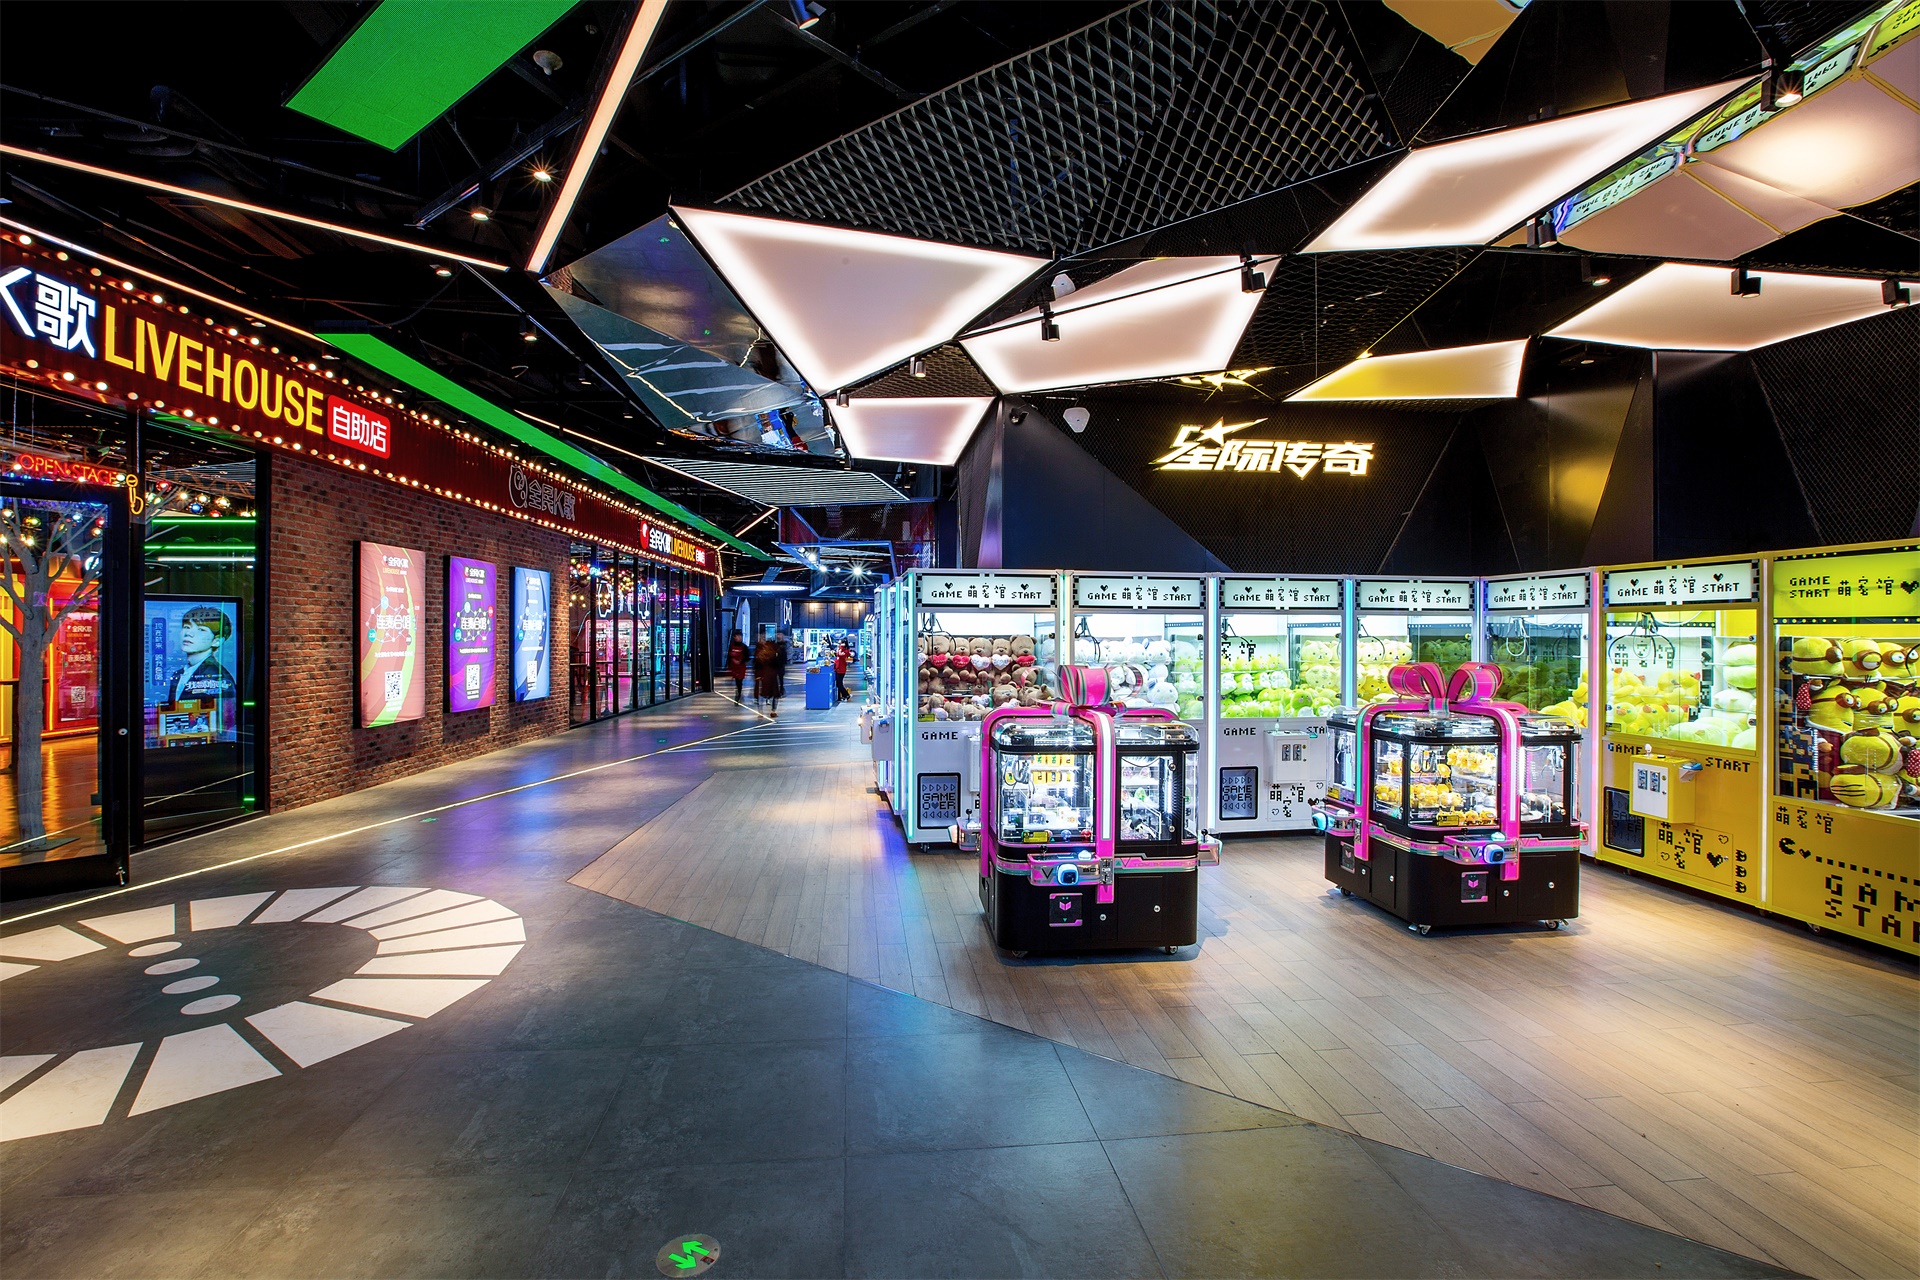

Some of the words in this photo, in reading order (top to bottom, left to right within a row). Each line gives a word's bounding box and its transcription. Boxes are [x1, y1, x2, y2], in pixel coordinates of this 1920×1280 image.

[105, 305, 324, 435] LIVEHOUSE
[332, 405, 387, 453] 自助店
[1149, 416, 1375, 480] 星际传奇
[20, 454, 68, 475] OPEN
[1790, 576, 1830, 586] GAME
[1618, 587, 1648, 597] GAME
[1702, 582, 1740, 593] START
[1789, 588, 1830, 599] START
[931, 590, 962, 598] GAME
[1011, 591, 1042, 599] START
[1087, 592, 1117, 600] GAME
[1163, 593, 1192, 601] START
[1233, 594, 1261, 602] GAME
[1303, 594, 1330, 602] START
[1494, 594, 1516, 603] GAME
[1551, 591, 1578, 600] START
[1368, 595, 1395, 603] GAME
[1435, 596, 1462, 604] START
[922, 732, 958, 740] GAME
[1223, 728, 1256, 736] GAME
[1607, 742, 1643, 755] GAME
[1705, 756, 1751, 773] START
[1222, 785, 1252, 794] GAME
[922, 793, 956, 802] GAME
